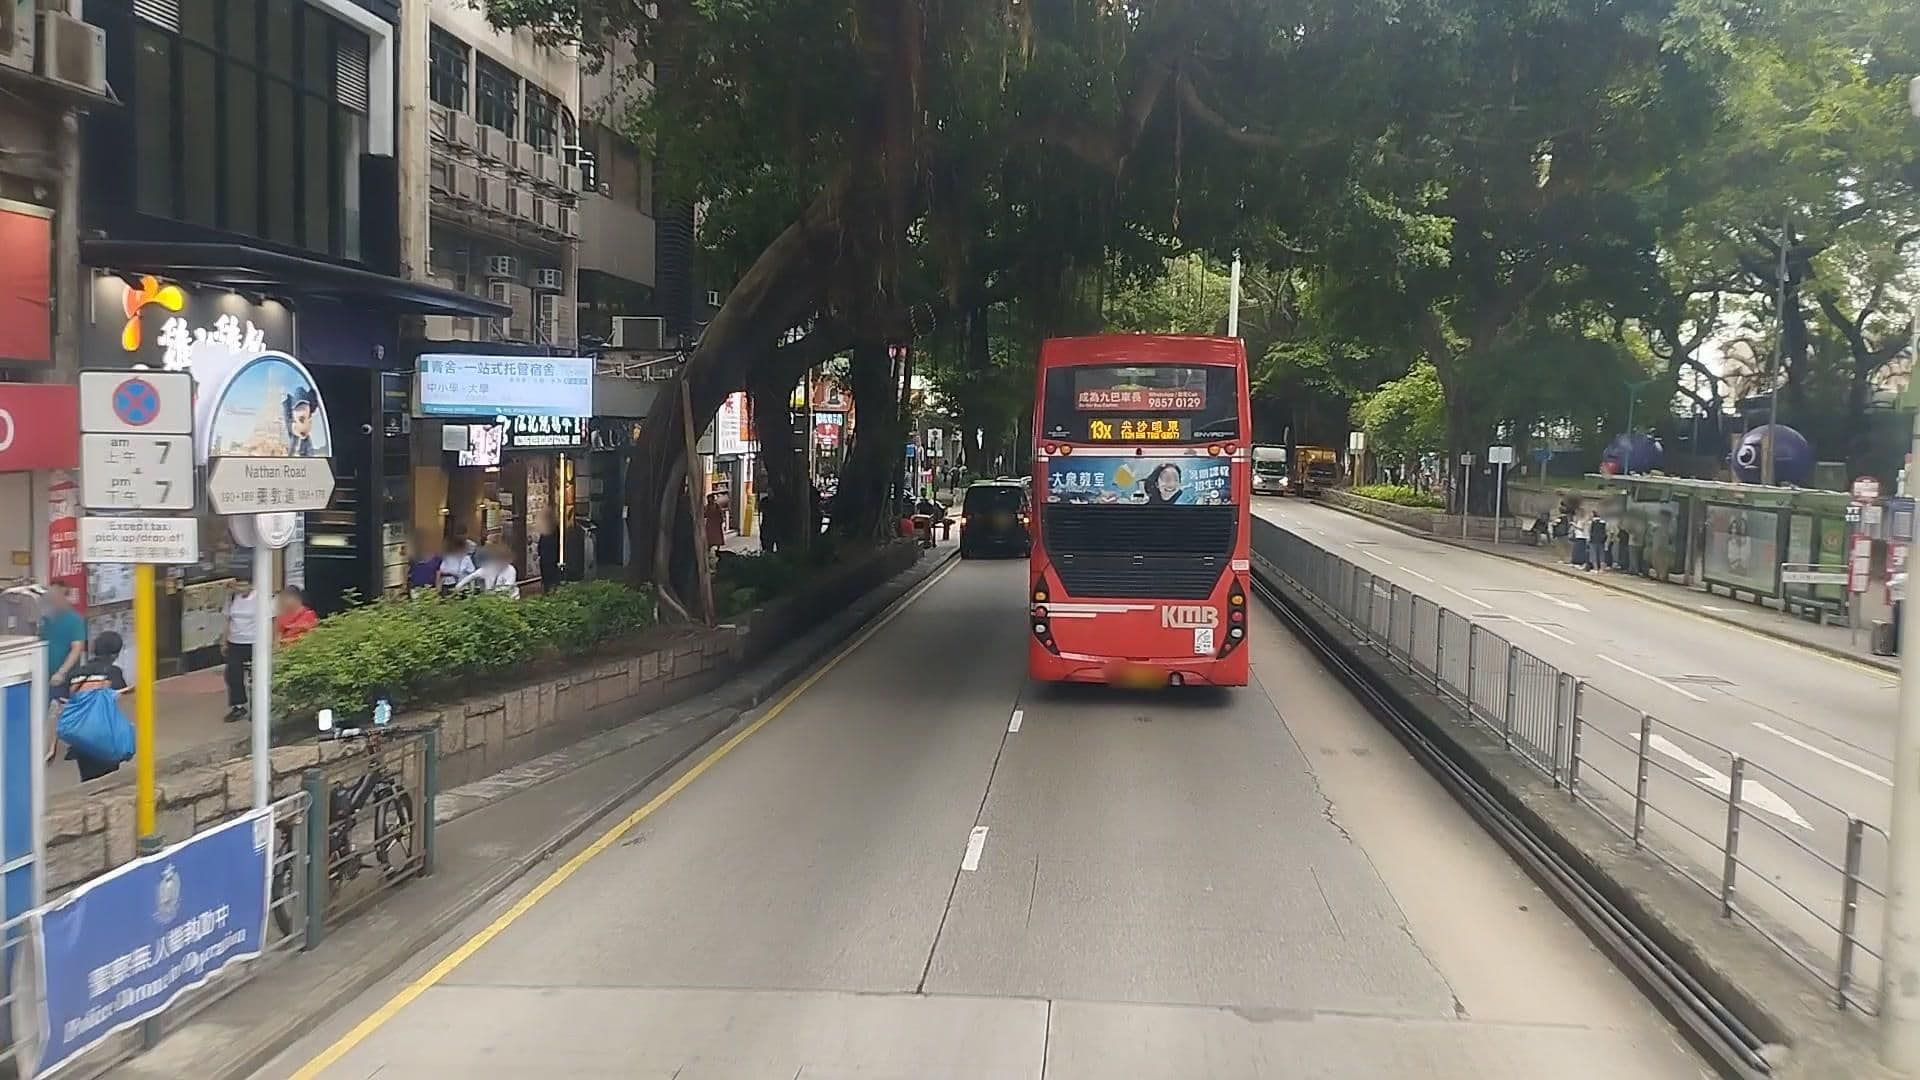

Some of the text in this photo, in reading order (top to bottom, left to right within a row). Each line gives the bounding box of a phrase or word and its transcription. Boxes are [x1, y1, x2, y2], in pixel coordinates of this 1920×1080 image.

[1079, 391, 1141, 402] 成為九巴車長
[1148, 398, 1201, 409] 9857 0129
[103, 449, 137, 465] 上午
[110, 439, 172, 465] am 7
[245, 464, 307, 478] Nathan Road
[104, 489, 137, 505] 下午
[111, 478, 173, 504] pm 7
[256, 487, 296, 505] 彌敦道
[95, 533, 119, 543] pick
